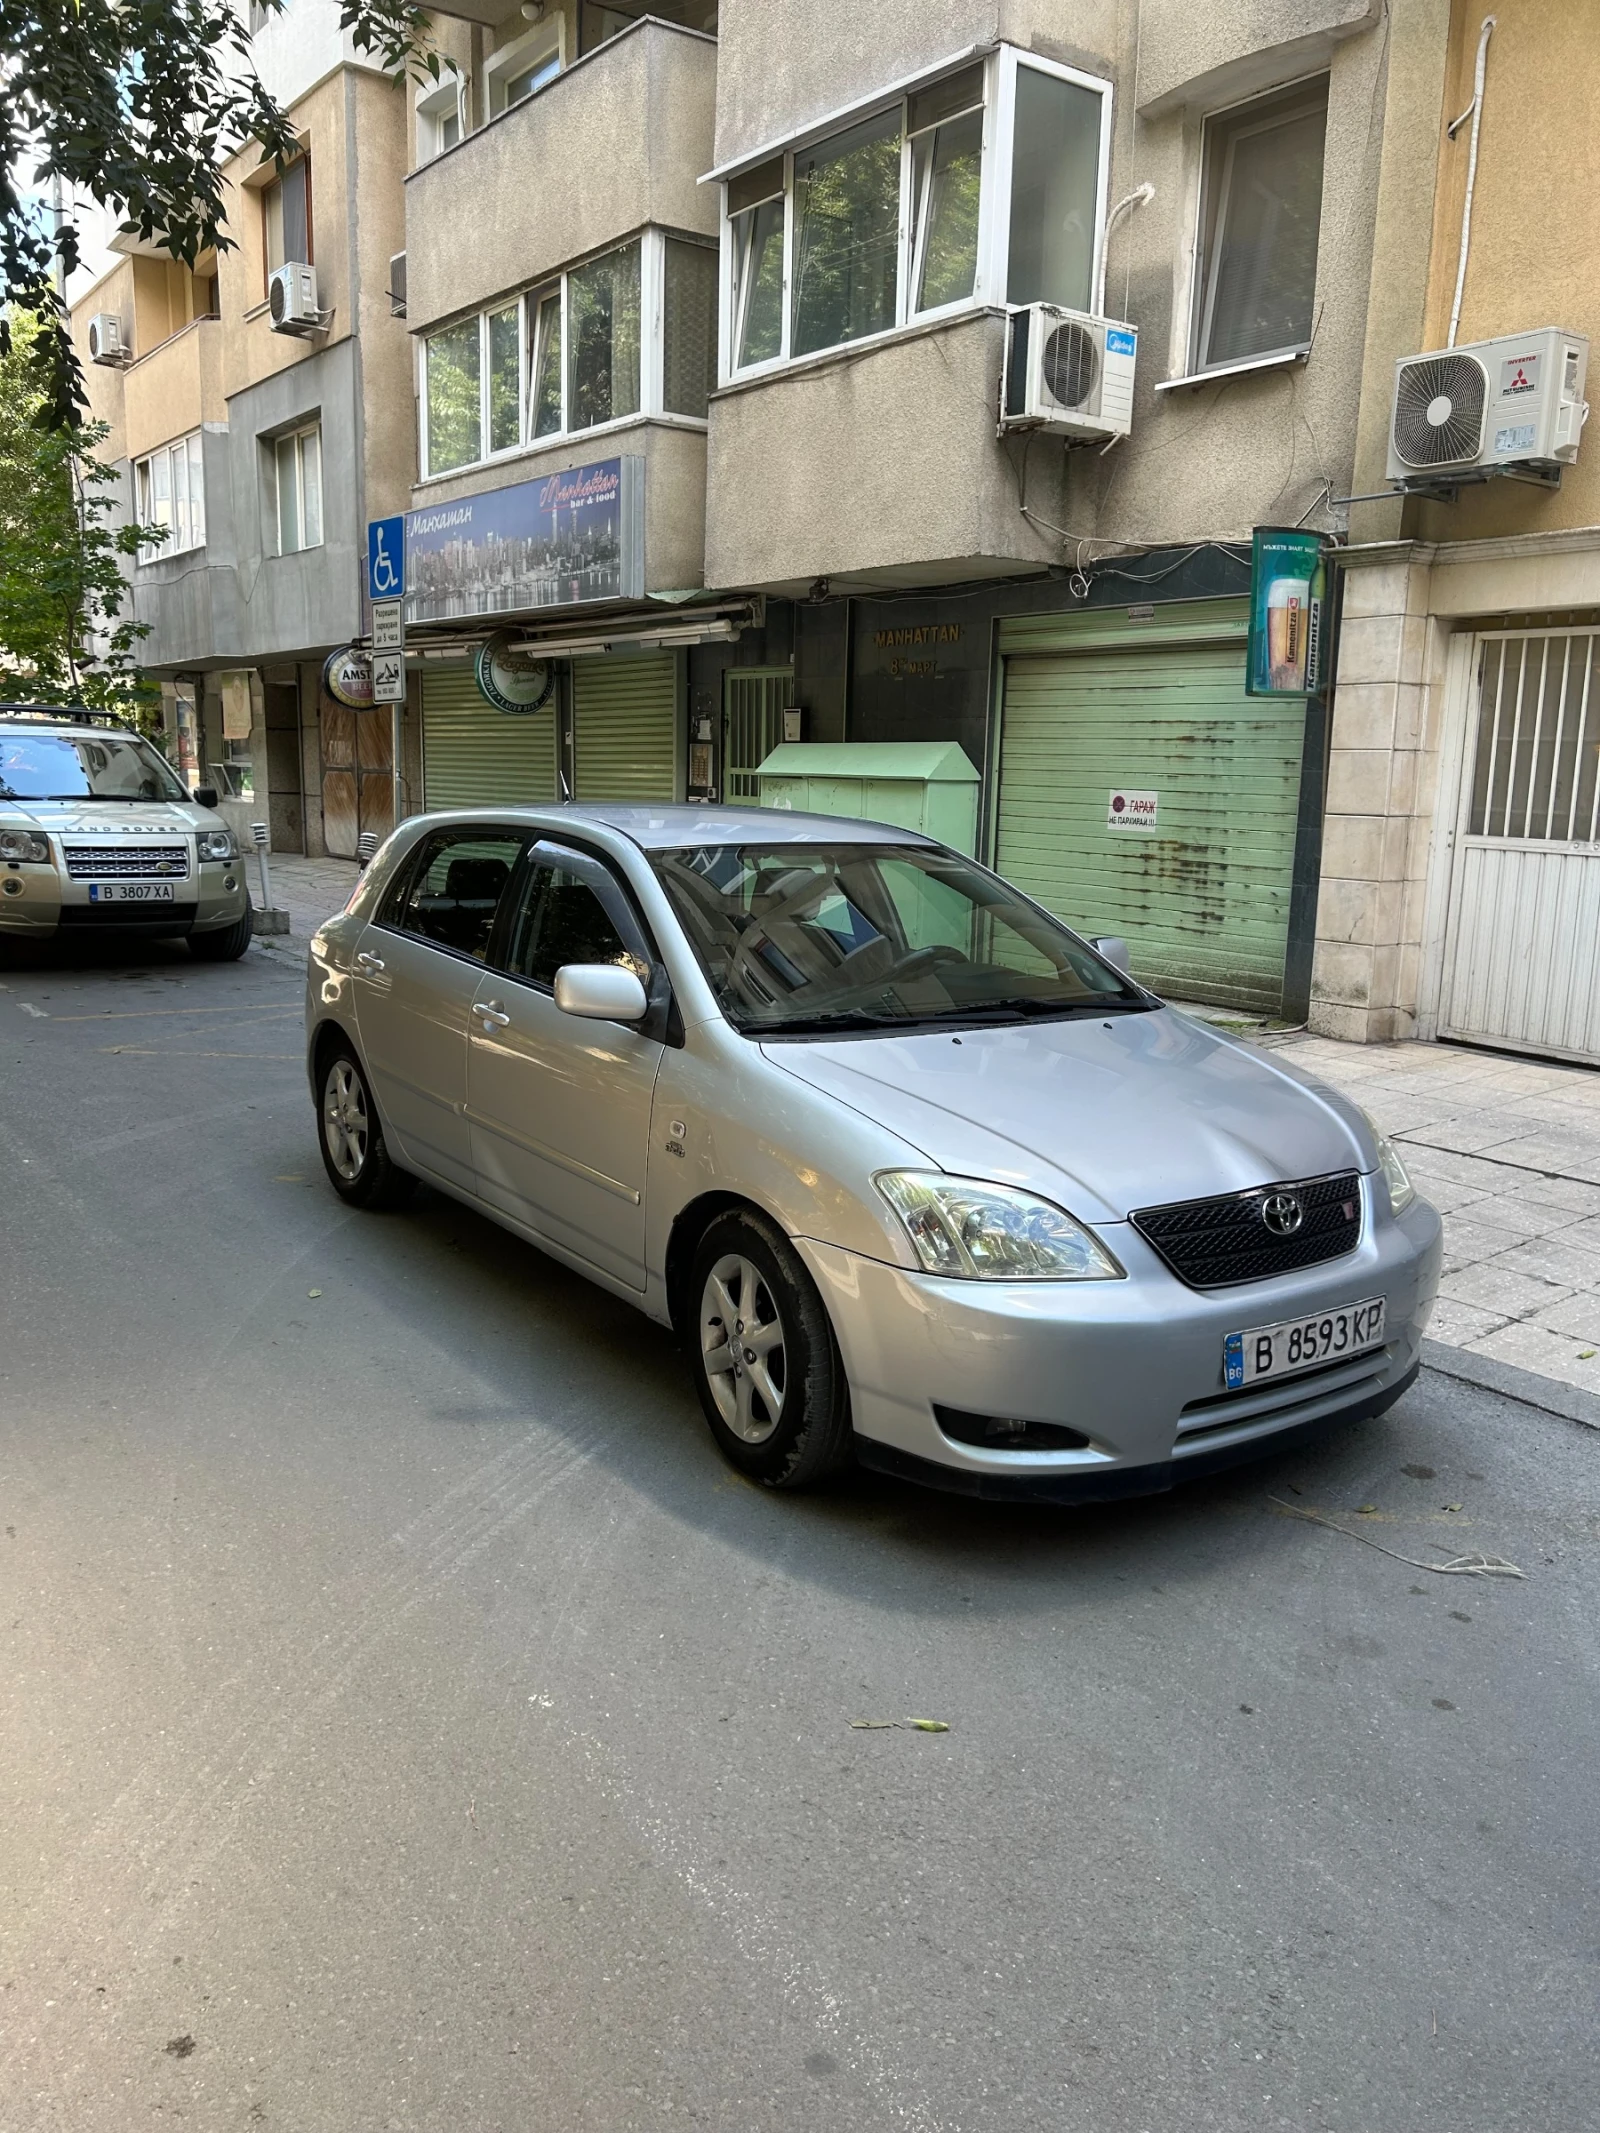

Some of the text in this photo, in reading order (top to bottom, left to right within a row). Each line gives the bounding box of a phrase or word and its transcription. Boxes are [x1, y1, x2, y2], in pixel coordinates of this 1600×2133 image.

[540, 469, 619, 508] Manhattan
[570, 499, 586, 509] bar
[596, 489, 616, 503] food
[875, 623, 960, 648] MANHATTAN
[1287, 612, 1297, 663] Kamenitza
[1307, 602, 1319, 689] Kamenitza
[342, 669, 372, 681] AMST
[496, 652, 545, 676] Zagorka
[353, 683, 372, 691] BEE
[1129, 800, 1156, 814] ГАРАЖ
[104, 886, 171, 899] B 3807 XA
[1255, 1303, 1381, 1374] B 8593 KP
[1228, 1367, 1242, 1380] BG
